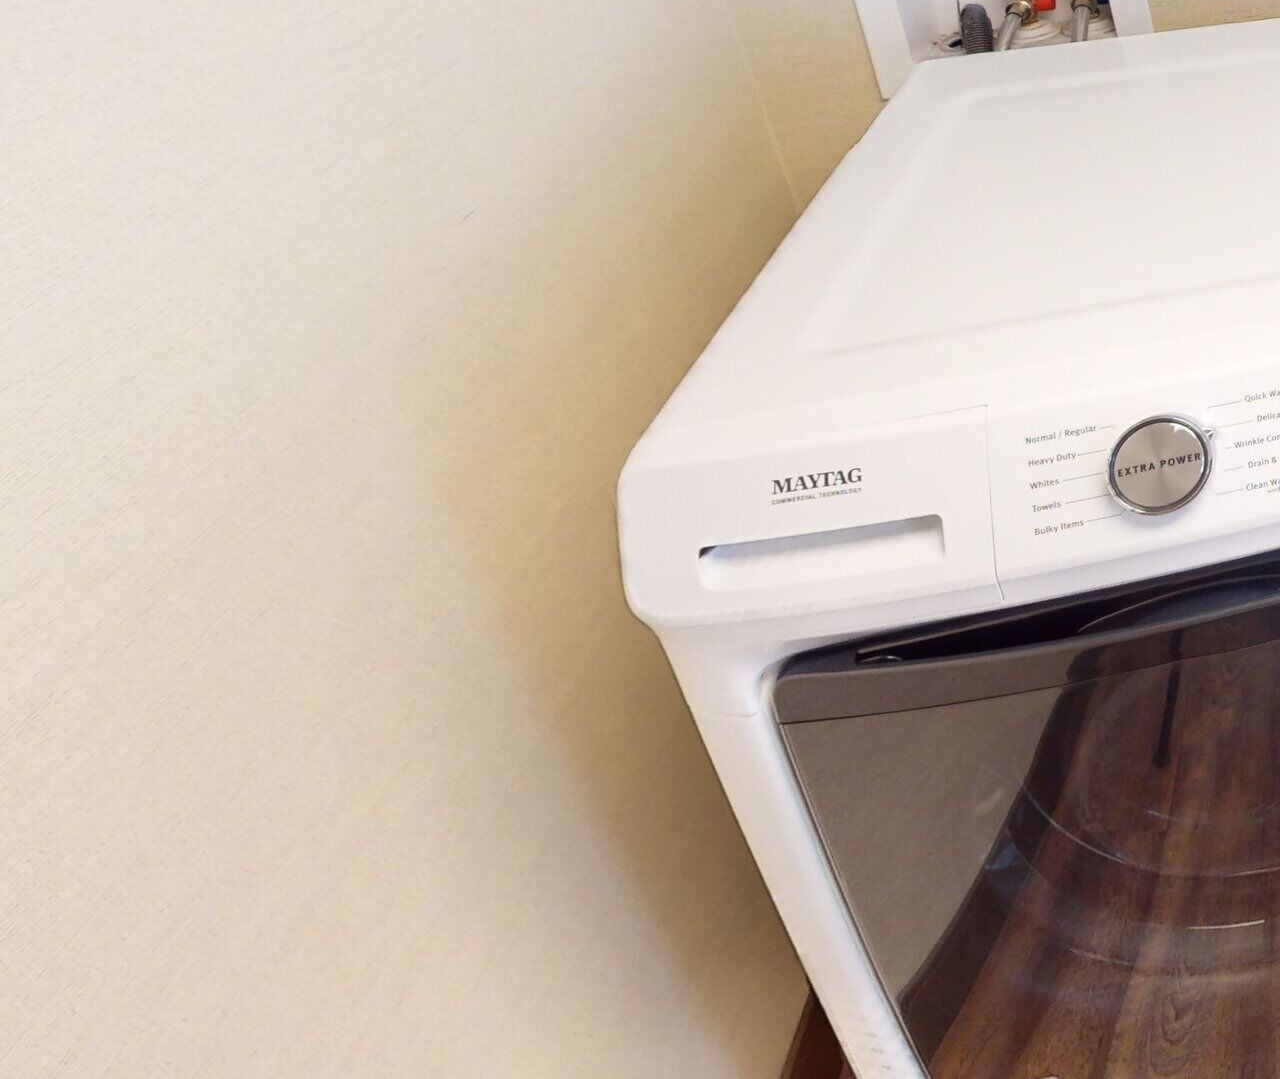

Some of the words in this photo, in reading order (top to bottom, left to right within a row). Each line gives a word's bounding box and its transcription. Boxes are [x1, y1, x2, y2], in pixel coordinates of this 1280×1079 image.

[1244, 392, 1267, 403] Quick
[1025, 430, 1057, 445] Normal
[1064, 424, 1097, 438] Regular
[1233, 437, 1265, 449] Wrinkle
[1028, 455, 1055, 467] Heavy
[1056, 451, 1077, 463] Duty
[1117, 462, 1156, 478] EXTRA
[1160, 452, 1201, 469] POWER
[1247, 458, 1269, 468] Drain
[771, 467, 863, 495] MAYTAG
[1029, 477, 1060, 490] Whites
[1246, 480, 1269, 491] Clean
[771, 494, 816, 506] COMMERCIAL
[819, 487, 862, 499] TECHNOLOGY
[1032, 500, 1062, 513] Towels
[1034, 523, 1059, 536] Bulky
[1060, 519, 1085, 531] Items
